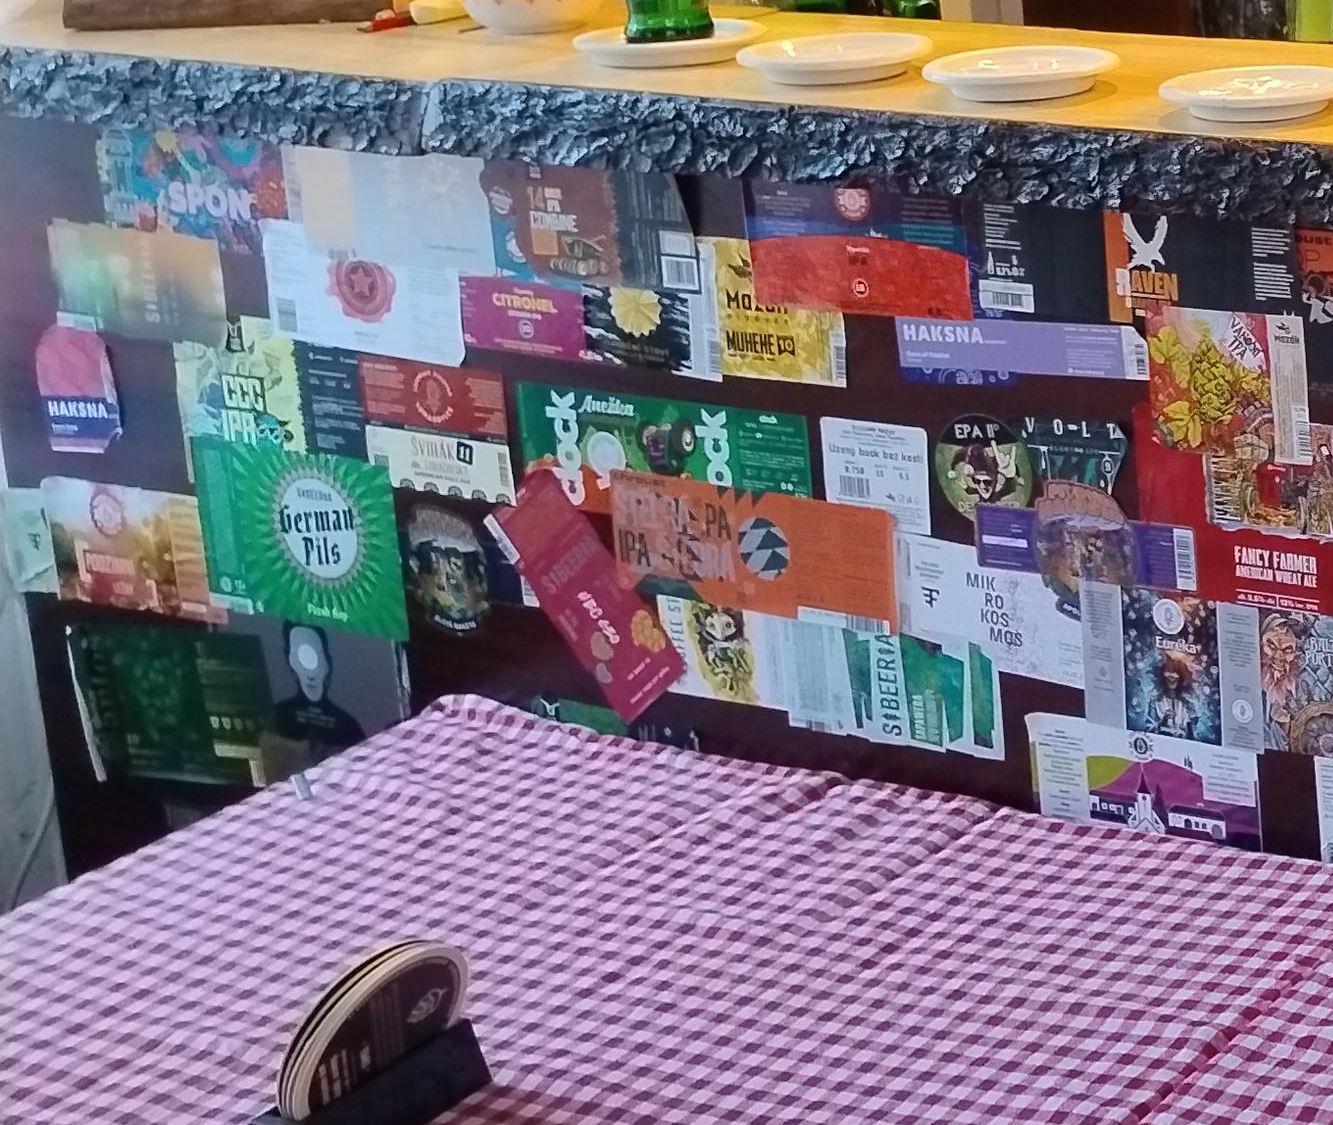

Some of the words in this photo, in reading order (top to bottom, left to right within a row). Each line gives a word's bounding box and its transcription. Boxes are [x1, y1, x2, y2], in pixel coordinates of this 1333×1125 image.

[726, 329, 775, 358] MUHEHE
[903, 324, 984, 346] HAKSNA
[48, 400, 109, 418] HAKSNA
[954, 423, 983, 440] EPA
[279, 504, 355, 535] German
[301, 535, 342, 567] Pils
[1234, 545, 1270, 568] FANCY
[1272, 551, 1318, 575] FARMER
[966, 571, 996, 591] MIK
[1235, 563, 1273, 582] AMERICAN
[1274, 570, 1302, 586] WHEAT
[1303, 574, 1318, 588] ALE
[985, 594, 1005, 610] RO
[980, 608, 1010, 628] KOS
[989, 624, 1024, 648] MOS
